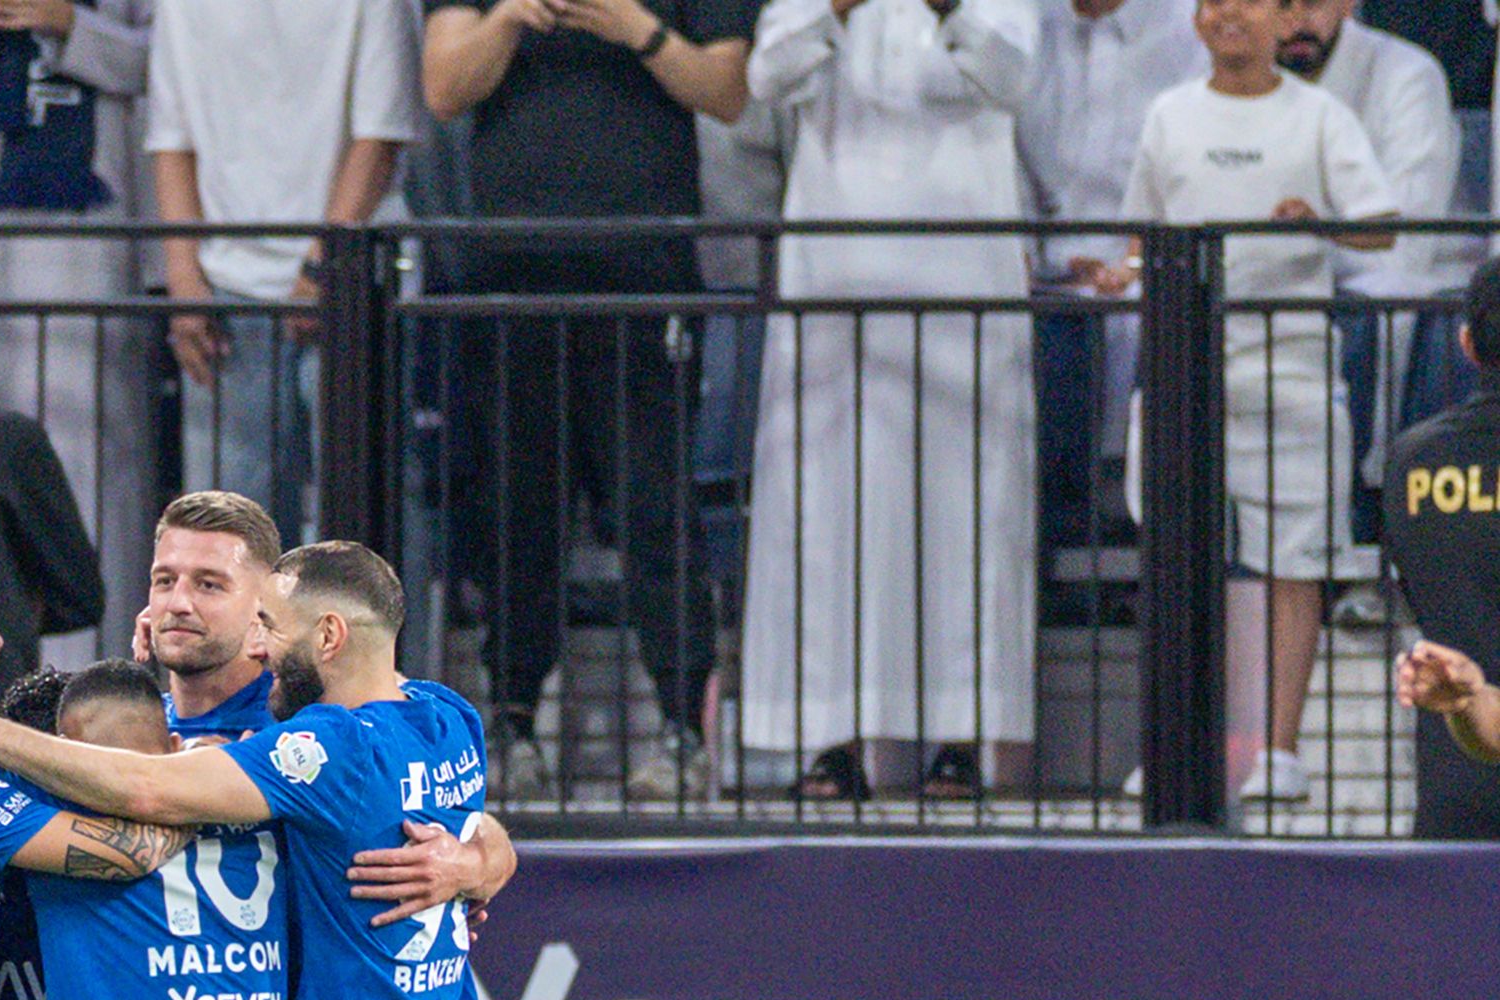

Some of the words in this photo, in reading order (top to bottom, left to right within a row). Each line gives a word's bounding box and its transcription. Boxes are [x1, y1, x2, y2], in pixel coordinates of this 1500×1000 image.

[157, 831, 279, 936] 10
[147, 941, 281, 977] MALCOM
[393, 954, 467, 993] BENZEM
